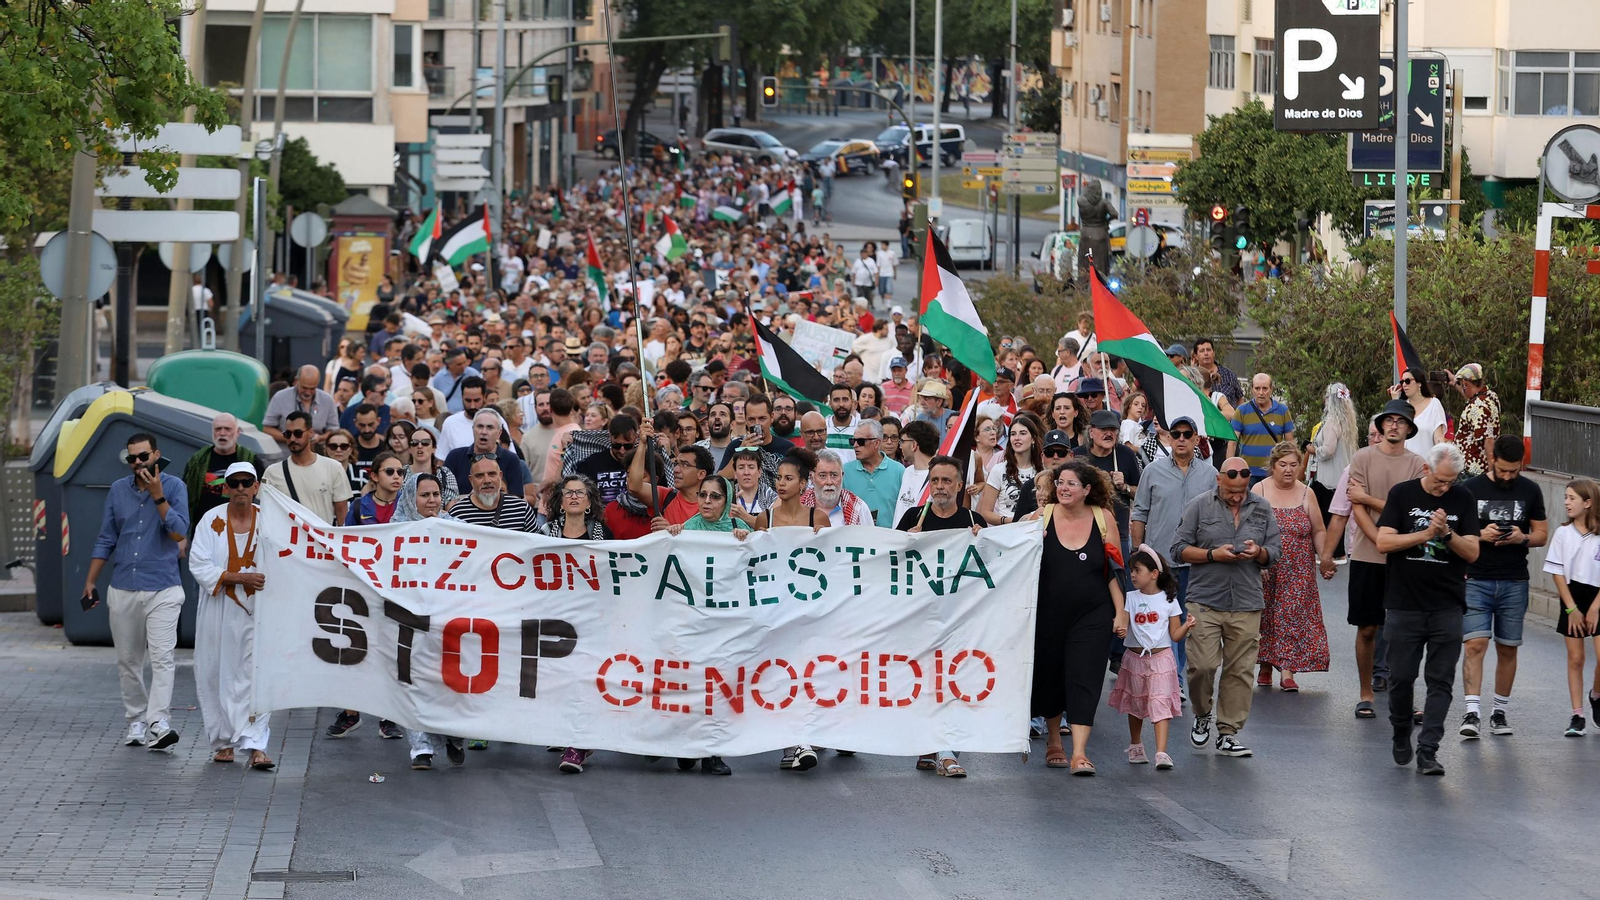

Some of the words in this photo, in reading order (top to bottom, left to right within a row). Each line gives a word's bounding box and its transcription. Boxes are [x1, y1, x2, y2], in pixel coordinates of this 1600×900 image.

[1283, 28, 1338, 101] P
[1285, 109, 1319, 119] Madre
[1322, 108, 1336, 118] de
[1338, 108, 1363, 118] Dios
[1362, 133, 1394, 143] Madre
[1410, 133, 1433, 144] Dios
[597, 480, 628, 489] FACT
[278, 513, 478, 591] JEREZ
[490, 552, 601, 591] CON
[608, 544, 996, 609] PALESTINA
[1134, 612, 1159, 624] LOVE
[311, 586, 578, 699] STOP
[595, 649, 996, 717] GENOCIDIO
